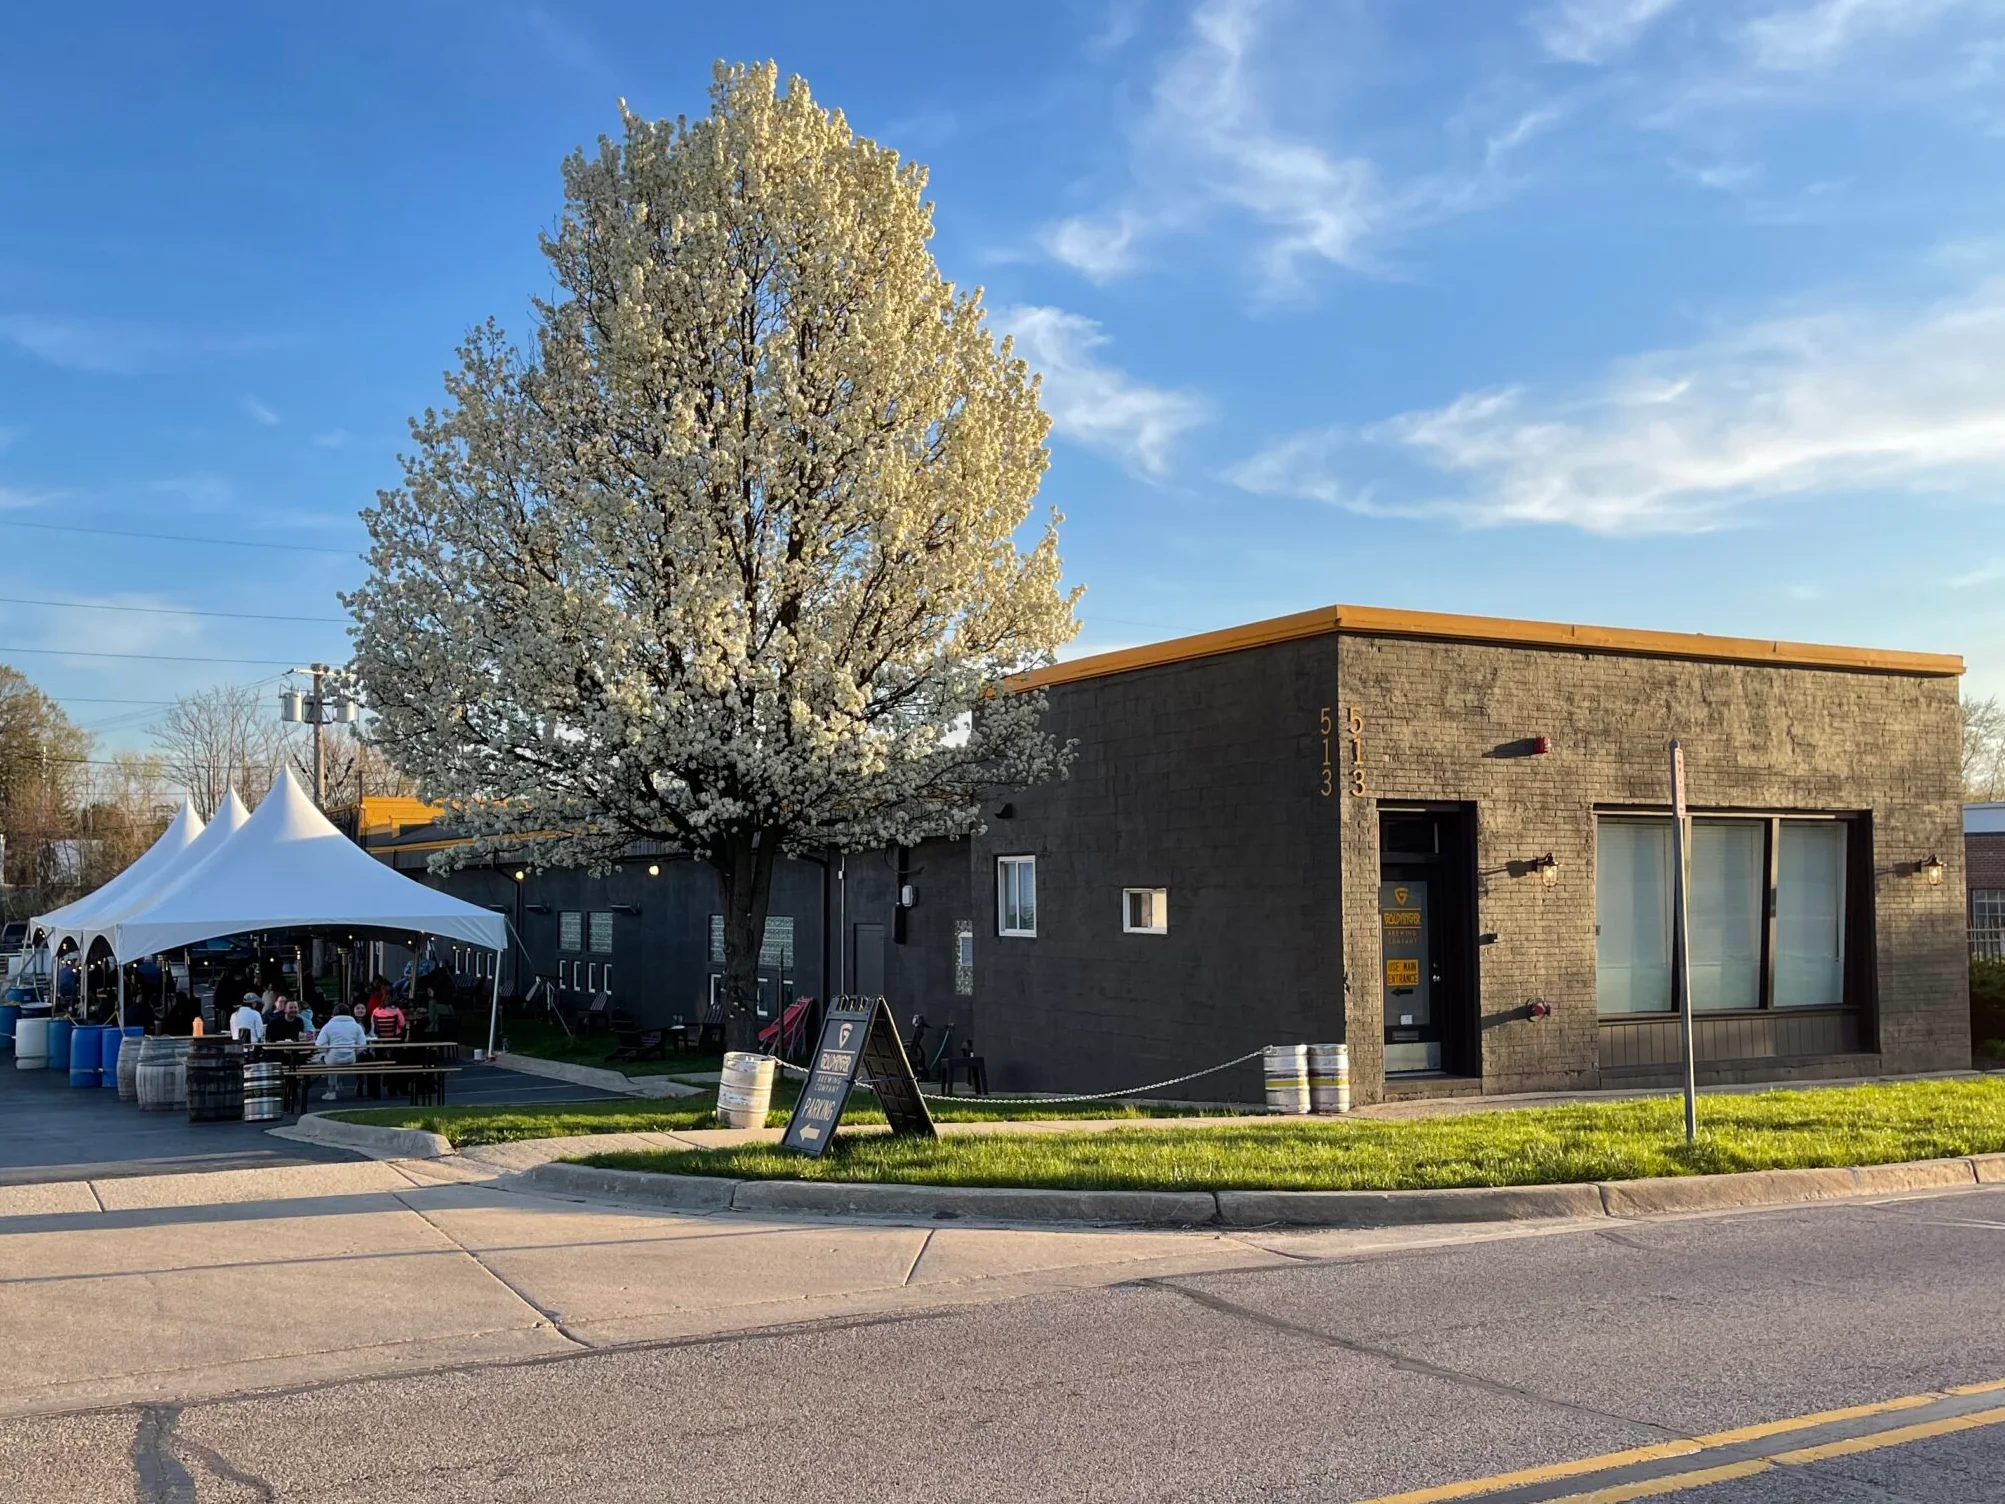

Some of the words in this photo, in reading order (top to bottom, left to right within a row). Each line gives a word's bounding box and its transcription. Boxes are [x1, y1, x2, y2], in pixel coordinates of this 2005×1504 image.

[1320, 707, 1332, 797] 513
[1350, 706, 1366, 797] 513
[1388, 962, 1400, 973] USE
[1403, 961, 1417, 972] MAIN
[1387, 973, 1418, 984] ENTRANCE
[817, 1075, 842, 1085] BREWING
[814, 1083, 840, 1093] COMPANY
[800, 1097, 836, 1121] PARKING
